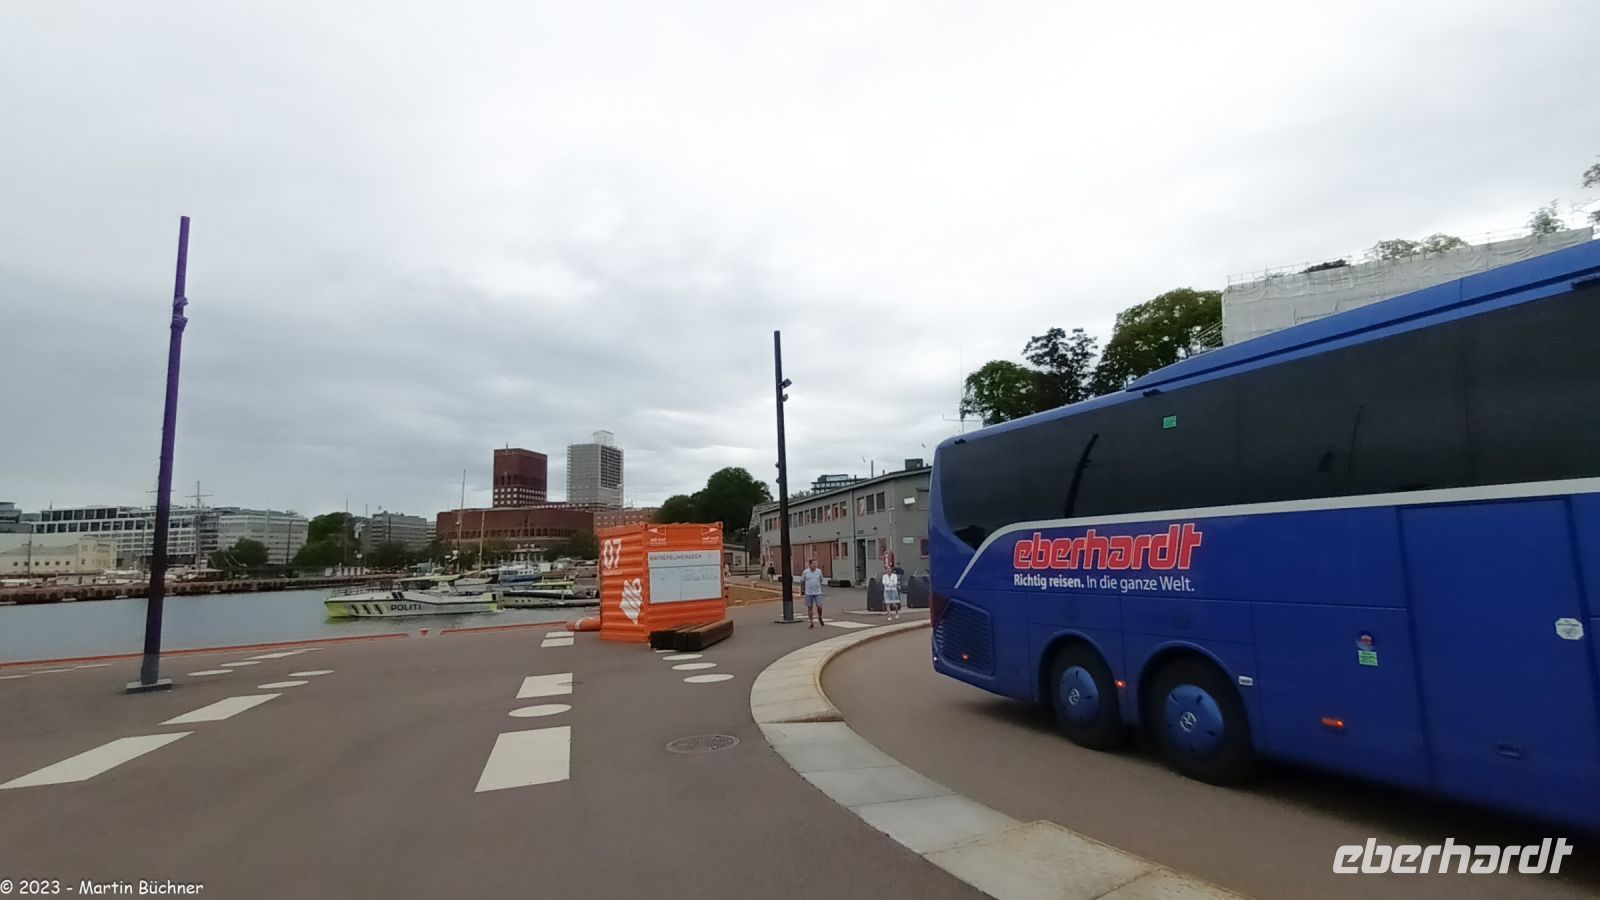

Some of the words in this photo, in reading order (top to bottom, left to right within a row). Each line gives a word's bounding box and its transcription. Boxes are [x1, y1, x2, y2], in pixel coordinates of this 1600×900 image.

[602, 538, 622, 570] 07
[1013, 523, 1203, 570] eberhardt
[1013, 573, 1047, 590] Richtig
[1049, 574, 1085, 588] reisen.
[1086, 575, 1097, 589] In
[1099, 575, 1117, 590] die
[1119, 577, 1157, 594] ganze
[1159, 576, 1195, 592] Welt.
[390, 603, 422, 612] POLITI
